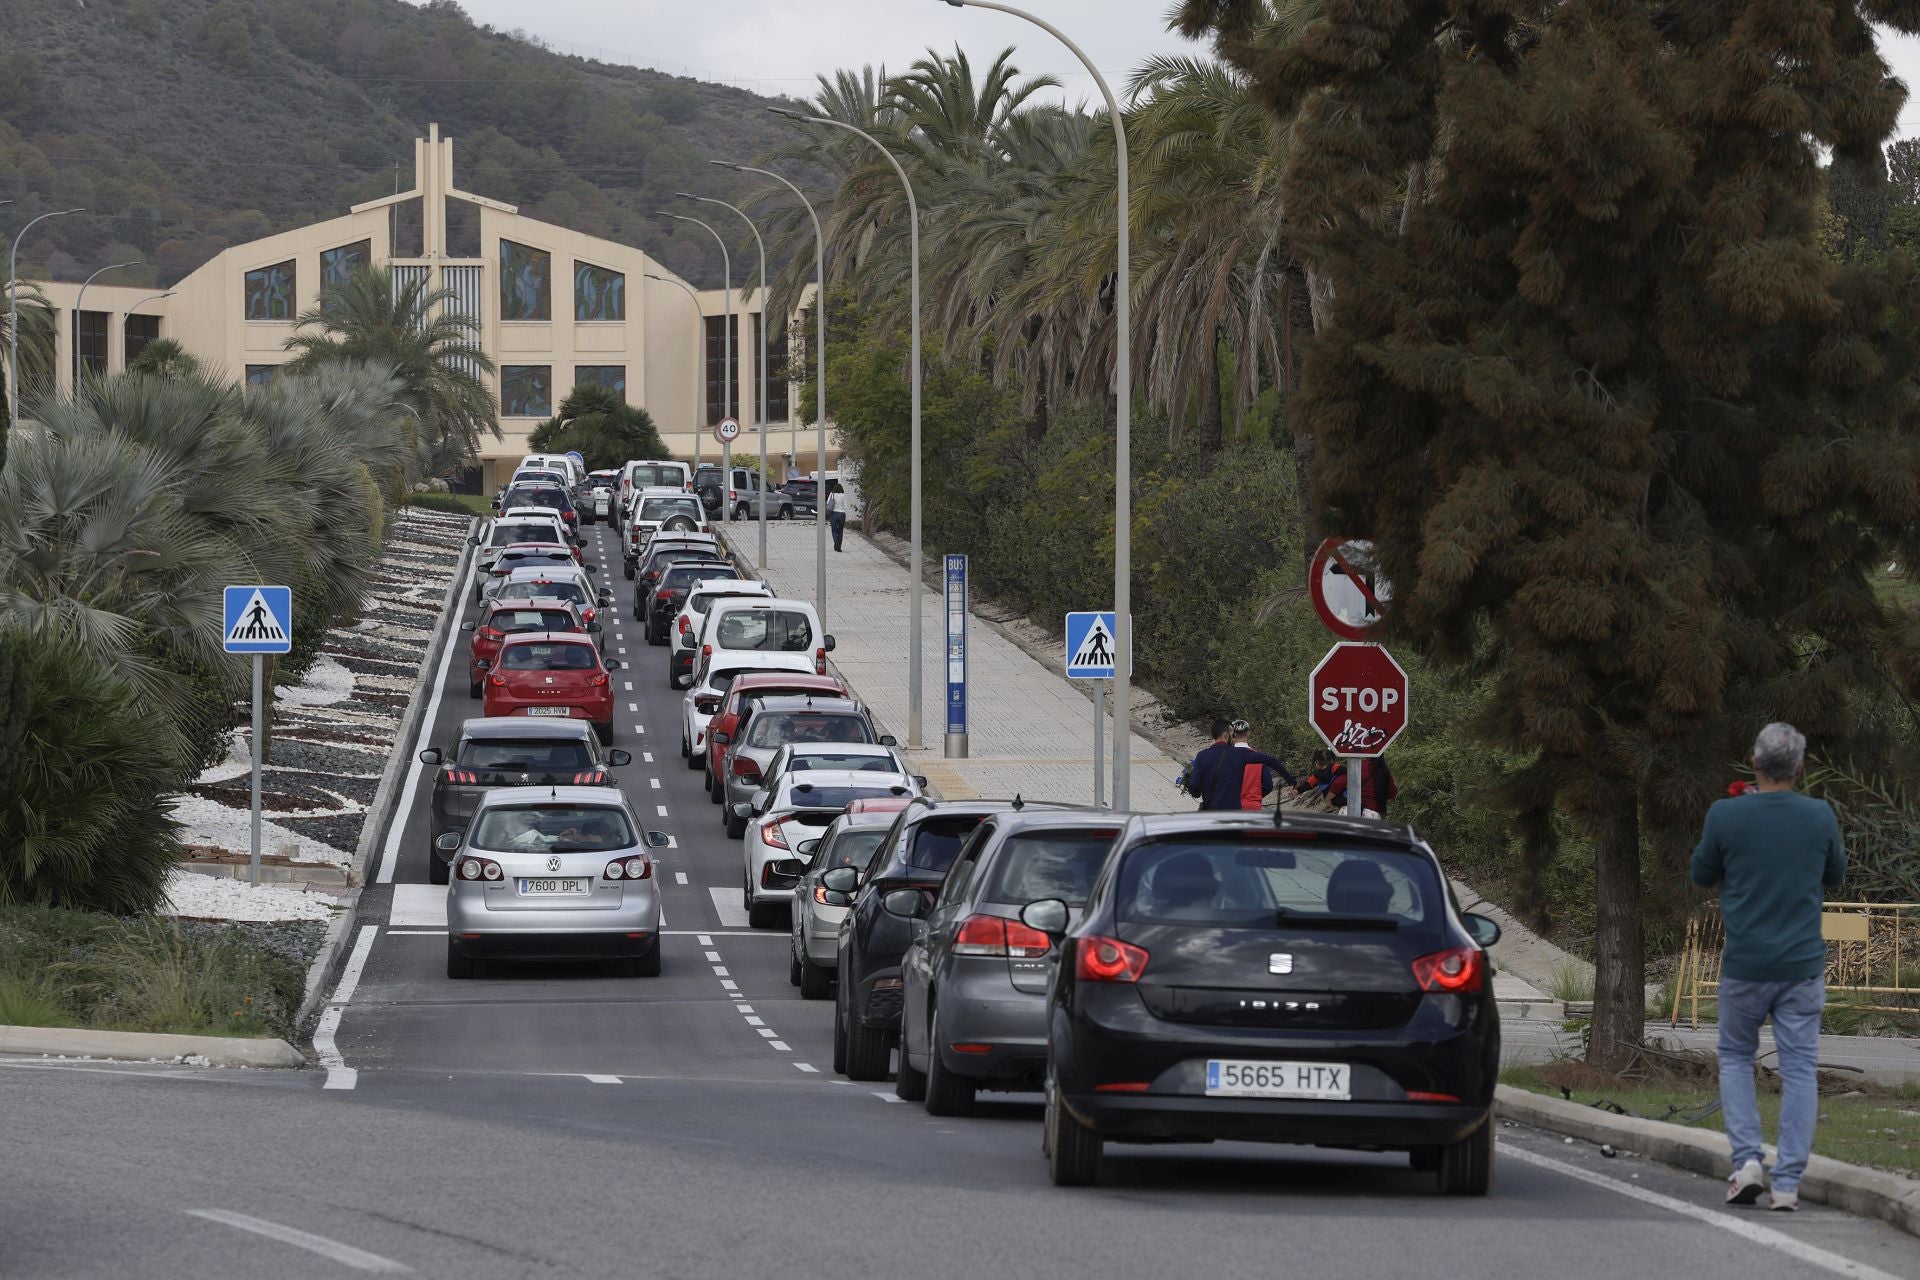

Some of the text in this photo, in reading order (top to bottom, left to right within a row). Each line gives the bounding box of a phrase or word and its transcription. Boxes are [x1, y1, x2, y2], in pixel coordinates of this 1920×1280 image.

[722, 425, 736, 433] 40
[948, 559, 964, 571] BUS
[1321, 687, 1399, 713] STOP
[534, 707, 552, 715] 2025
[528, 880, 583, 891] 7600 DPL
[1225, 1065, 1342, 1090] 5665 HTX
